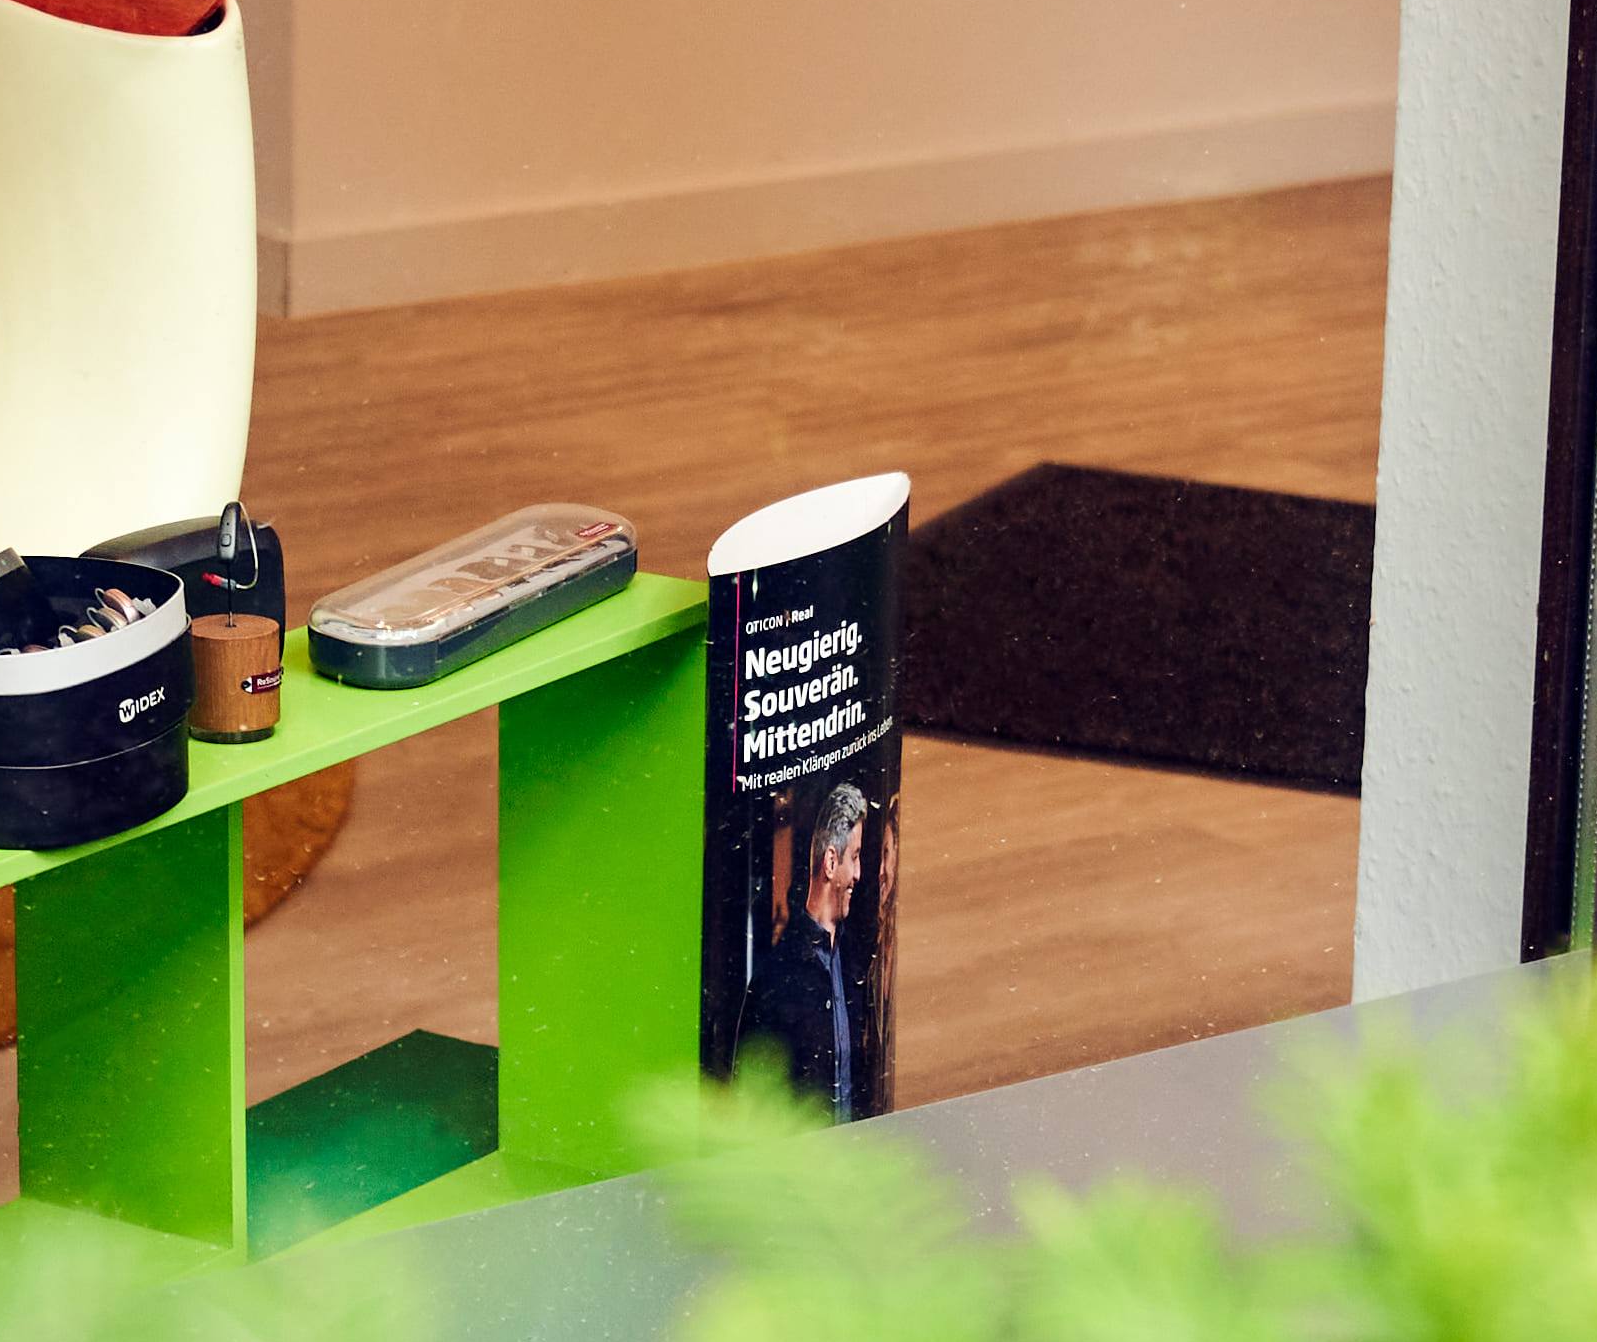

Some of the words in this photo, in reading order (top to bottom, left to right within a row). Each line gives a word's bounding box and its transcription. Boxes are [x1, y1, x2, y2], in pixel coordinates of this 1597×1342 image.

[745, 615, 783, 636] OTICON
[791, 604, 814, 624] Real
[745, 619, 863, 680] Neugierig.
[119, 686, 166, 723] WIDEX
[744, 662, 859, 722] Souverän.
[741, 774, 762, 792] Mit
[764, 764, 801, 785] realen
[802, 749, 841, 775] Klängen
[841, 733, 867, 759] zurück
[867, 729, 877, 745] ins
[743, 699, 866, 763] Mittendrin.
